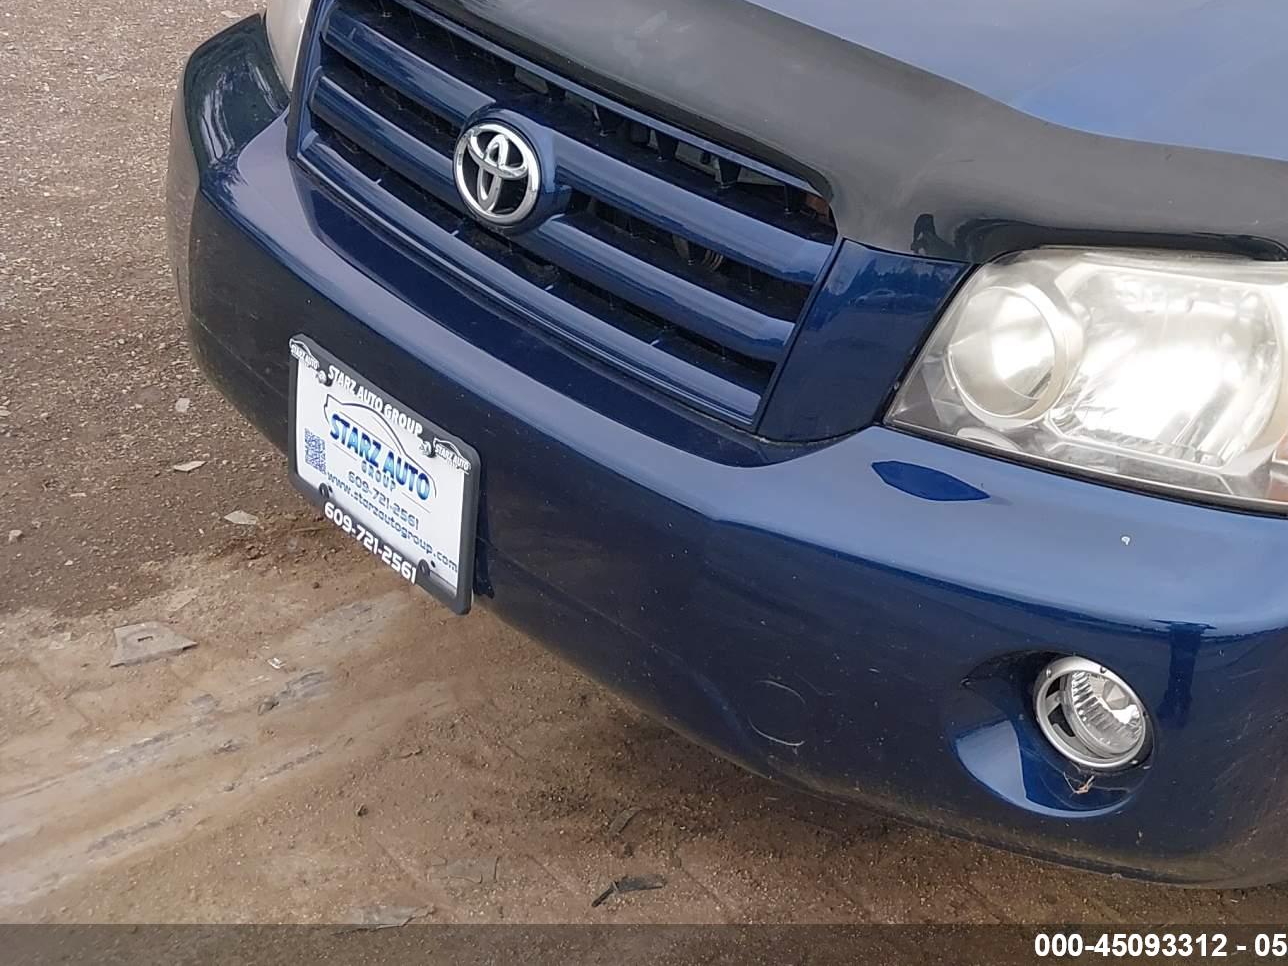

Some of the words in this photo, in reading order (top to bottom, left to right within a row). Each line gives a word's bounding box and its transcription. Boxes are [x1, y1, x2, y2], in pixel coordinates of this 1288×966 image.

[328, 365, 357, 397] STARZ
[357, 385, 384, 413] AUTO
[384, 403, 423, 438] GROUP
[330, 413, 381, 468] STARZ
[383, 451, 431, 501] AUTO
[361, 460, 396, 492] GROUP
[326, 471, 458, 573] www.starzautogroup.com
[347, 470, 420, 531] 609-721-2561
[324, 501, 417, 585] 609-721-2561
